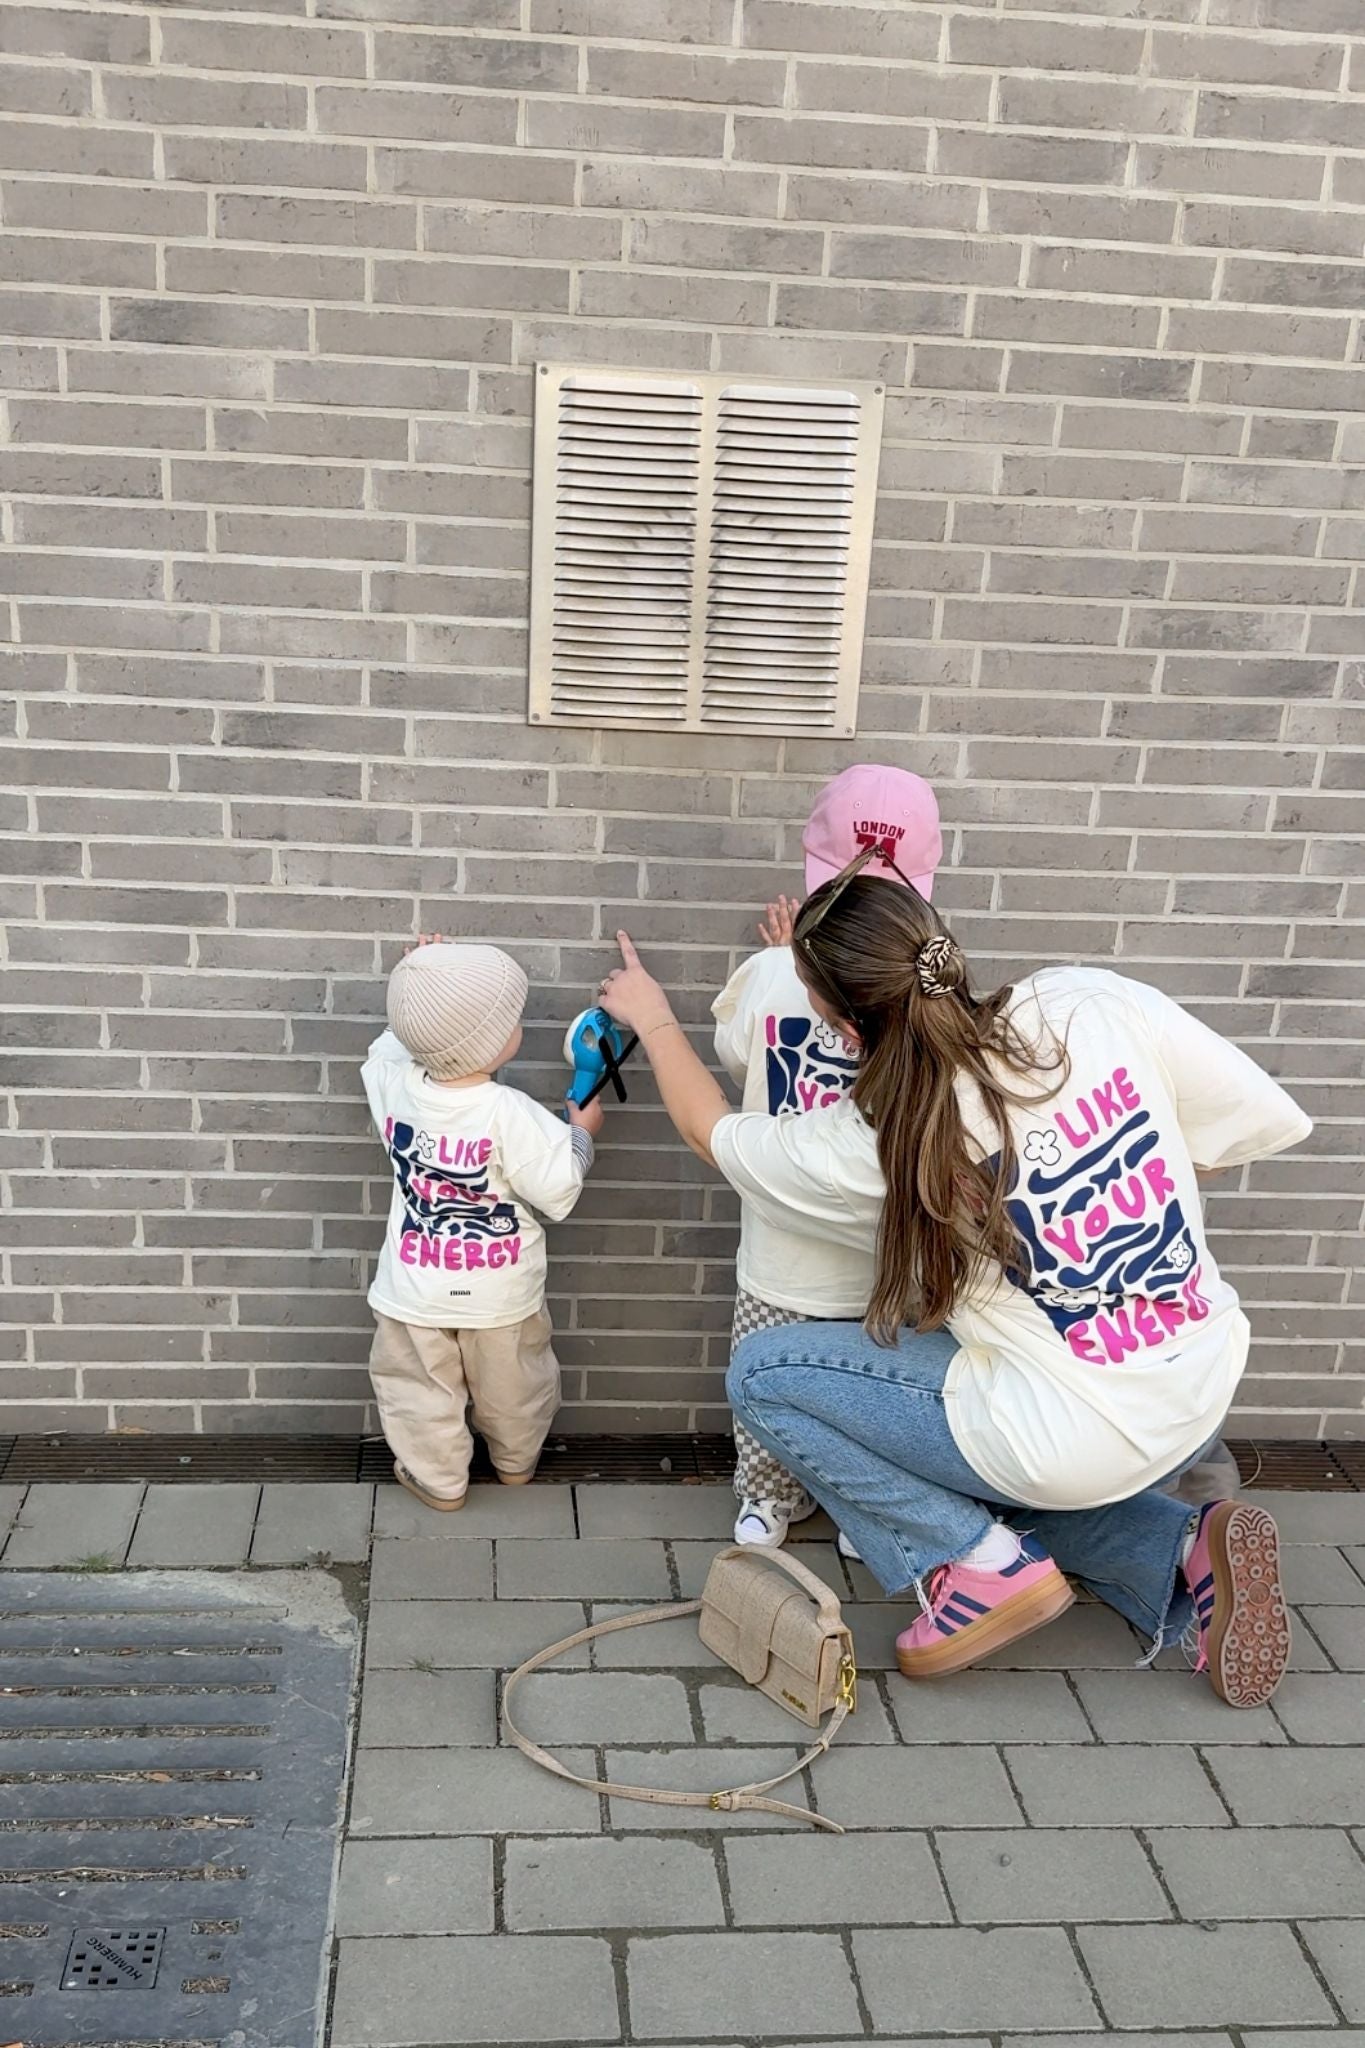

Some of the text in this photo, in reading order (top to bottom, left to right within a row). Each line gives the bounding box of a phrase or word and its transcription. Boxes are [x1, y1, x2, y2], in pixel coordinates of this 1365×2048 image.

[853, 821, 906, 840] LONDON
[1054, 1067, 1141, 1149] LIKE
[438, 1135, 493, 1168] LIKE
[1042, 1158, 1175, 1263] YOUR
[400, 1232, 521, 1271] ENERGY
[86, 1936, 142, 1981] HUMBERG
